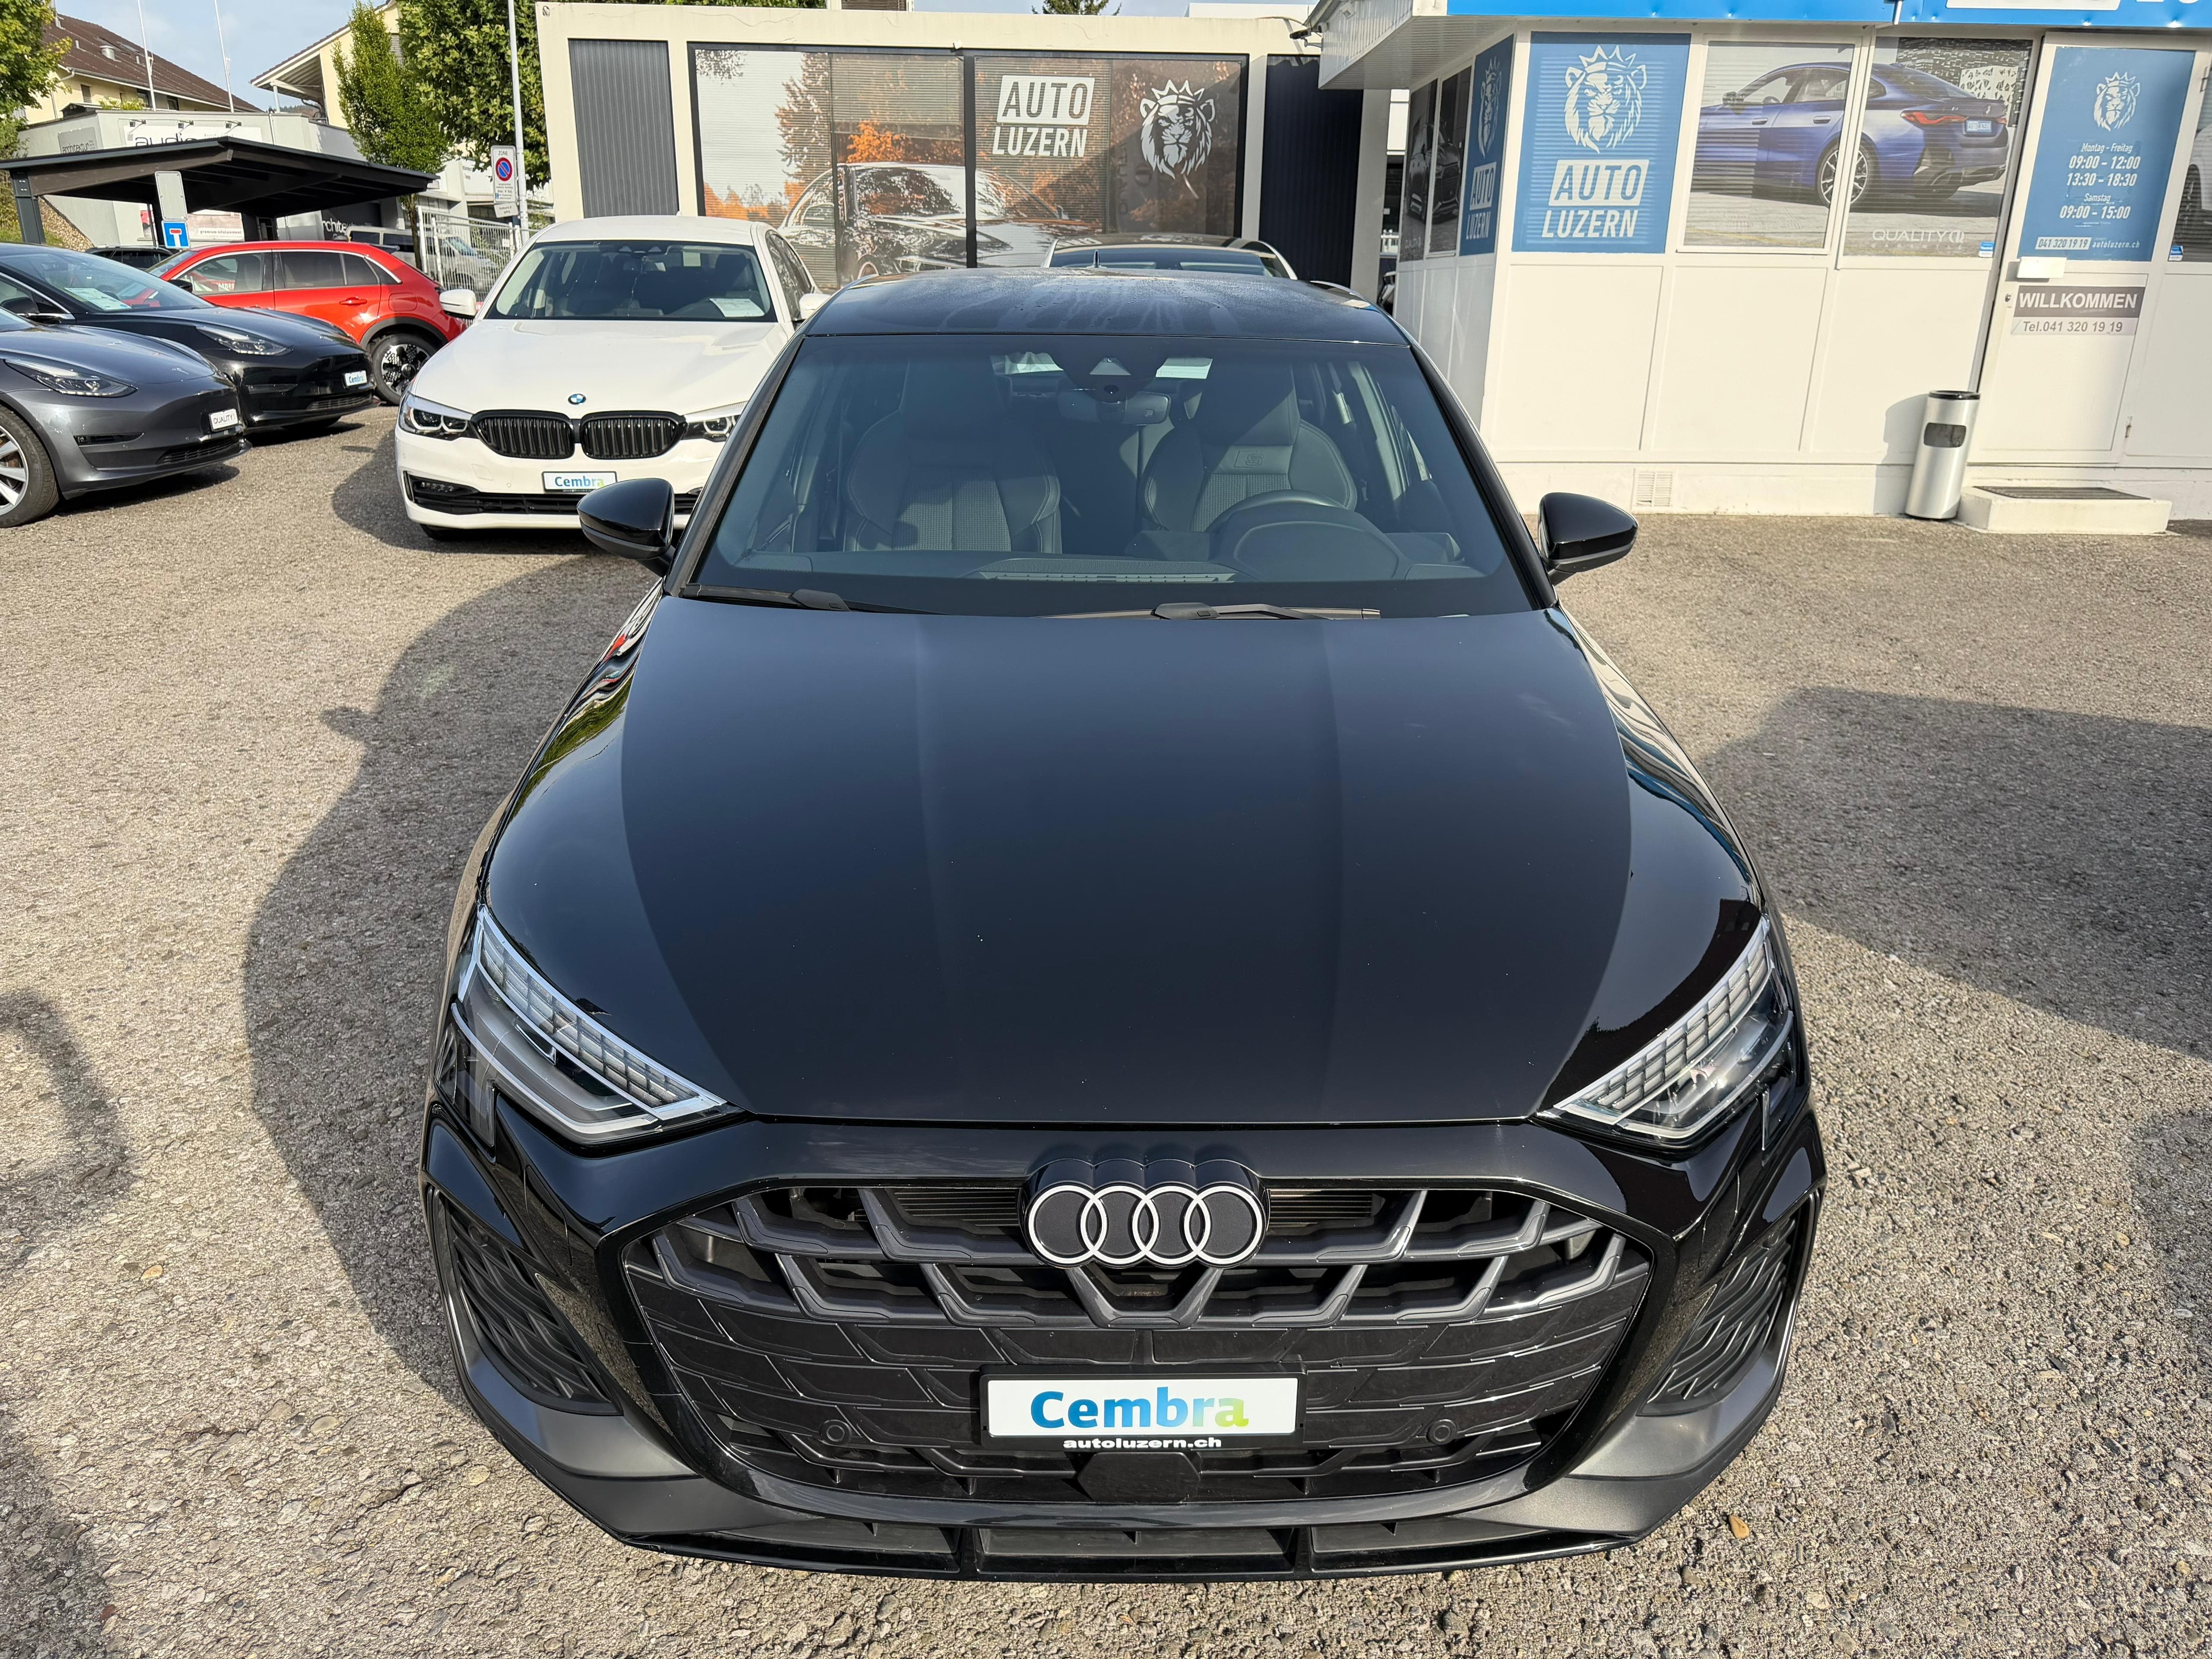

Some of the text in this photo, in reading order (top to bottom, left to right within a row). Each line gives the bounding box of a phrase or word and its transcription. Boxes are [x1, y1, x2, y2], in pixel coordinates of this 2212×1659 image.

[1002, 82, 1087, 119] AUTO
[992, 127, 1087, 157] LUZERN
[2082, 143, 2104, 153] Montag
[2111, 143, 2133, 153] Freitag
[2069, 156, 2100, 169] 09:00
[2110, 156, 2141, 169] 12:00
[1471, 167, 1494, 204] AUTO
[1555, 165, 1643, 200] AUTO
[2067, 173, 2096, 186] 13:30
[2107, 173, 2137, 186] 18:30
[2084, 194, 2111, 202] Samstag
[2059, 206, 2091, 219] 09:00
[2101, 206, 2131, 219] 15:00
[1466, 210, 1491, 240] LUZERN
[1542, 210, 1638, 238] LUZERN
[2038, 239, 2140, 248] 041 320 19 19 autoluzern.ch
[2019, 293, 2137, 308] WILLKOMMEN
[2023, 321, 2123, 332] Tel.041 320 19 19
[555, 476, 604, 487] Cembra
[1031, 1386, 1249, 1428] Cembra
[1063, 1437, 1222, 1449] autoluzern.ch
